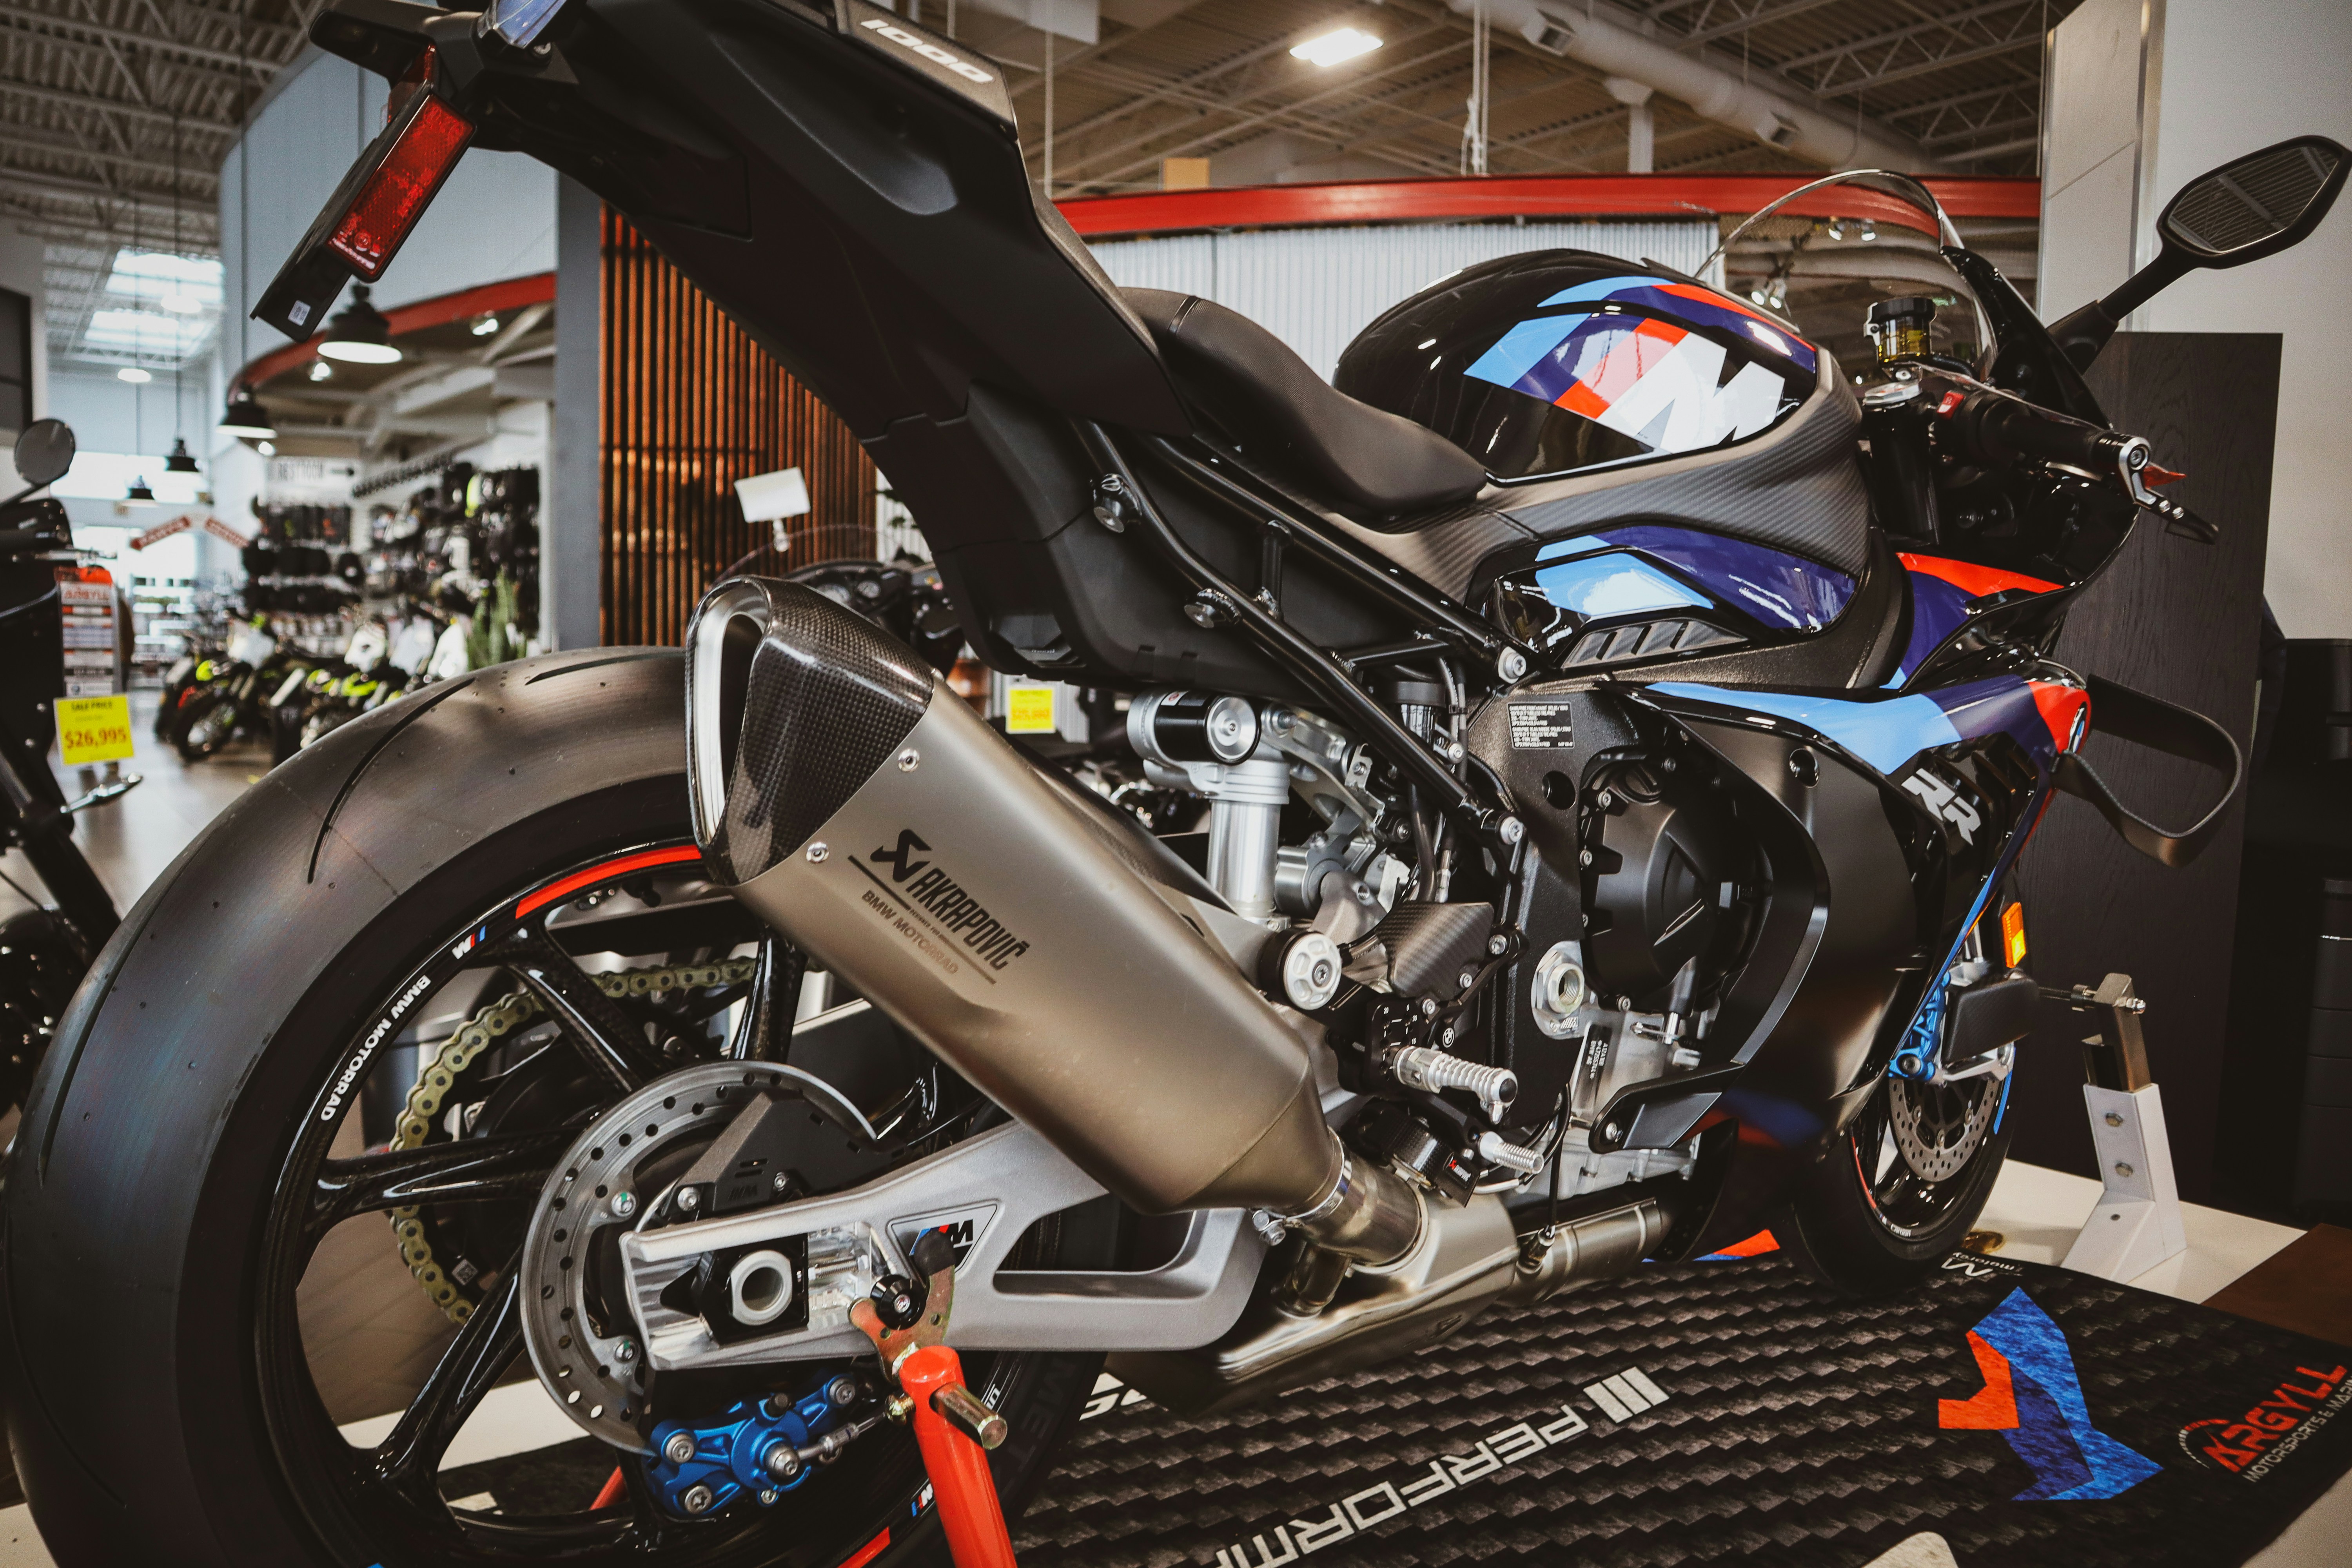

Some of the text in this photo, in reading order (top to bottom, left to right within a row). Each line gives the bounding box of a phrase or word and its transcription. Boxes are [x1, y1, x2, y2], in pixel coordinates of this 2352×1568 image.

[860, 19, 995, 83] 1000
[65, 727, 127, 750] $26,995
[1901, 768, 1981, 846] RR
[862, 890, 959, 975] BMW MOTORRAD
[321, 975, 431, 1121] BMW MOTORRAD
[2203, 1365, 2347, 1473] ARGYLL
[2242, 1415, 2327, 1483] MOTORSPORTS
[1214, 1404, 1589, 1568] PERFORM
